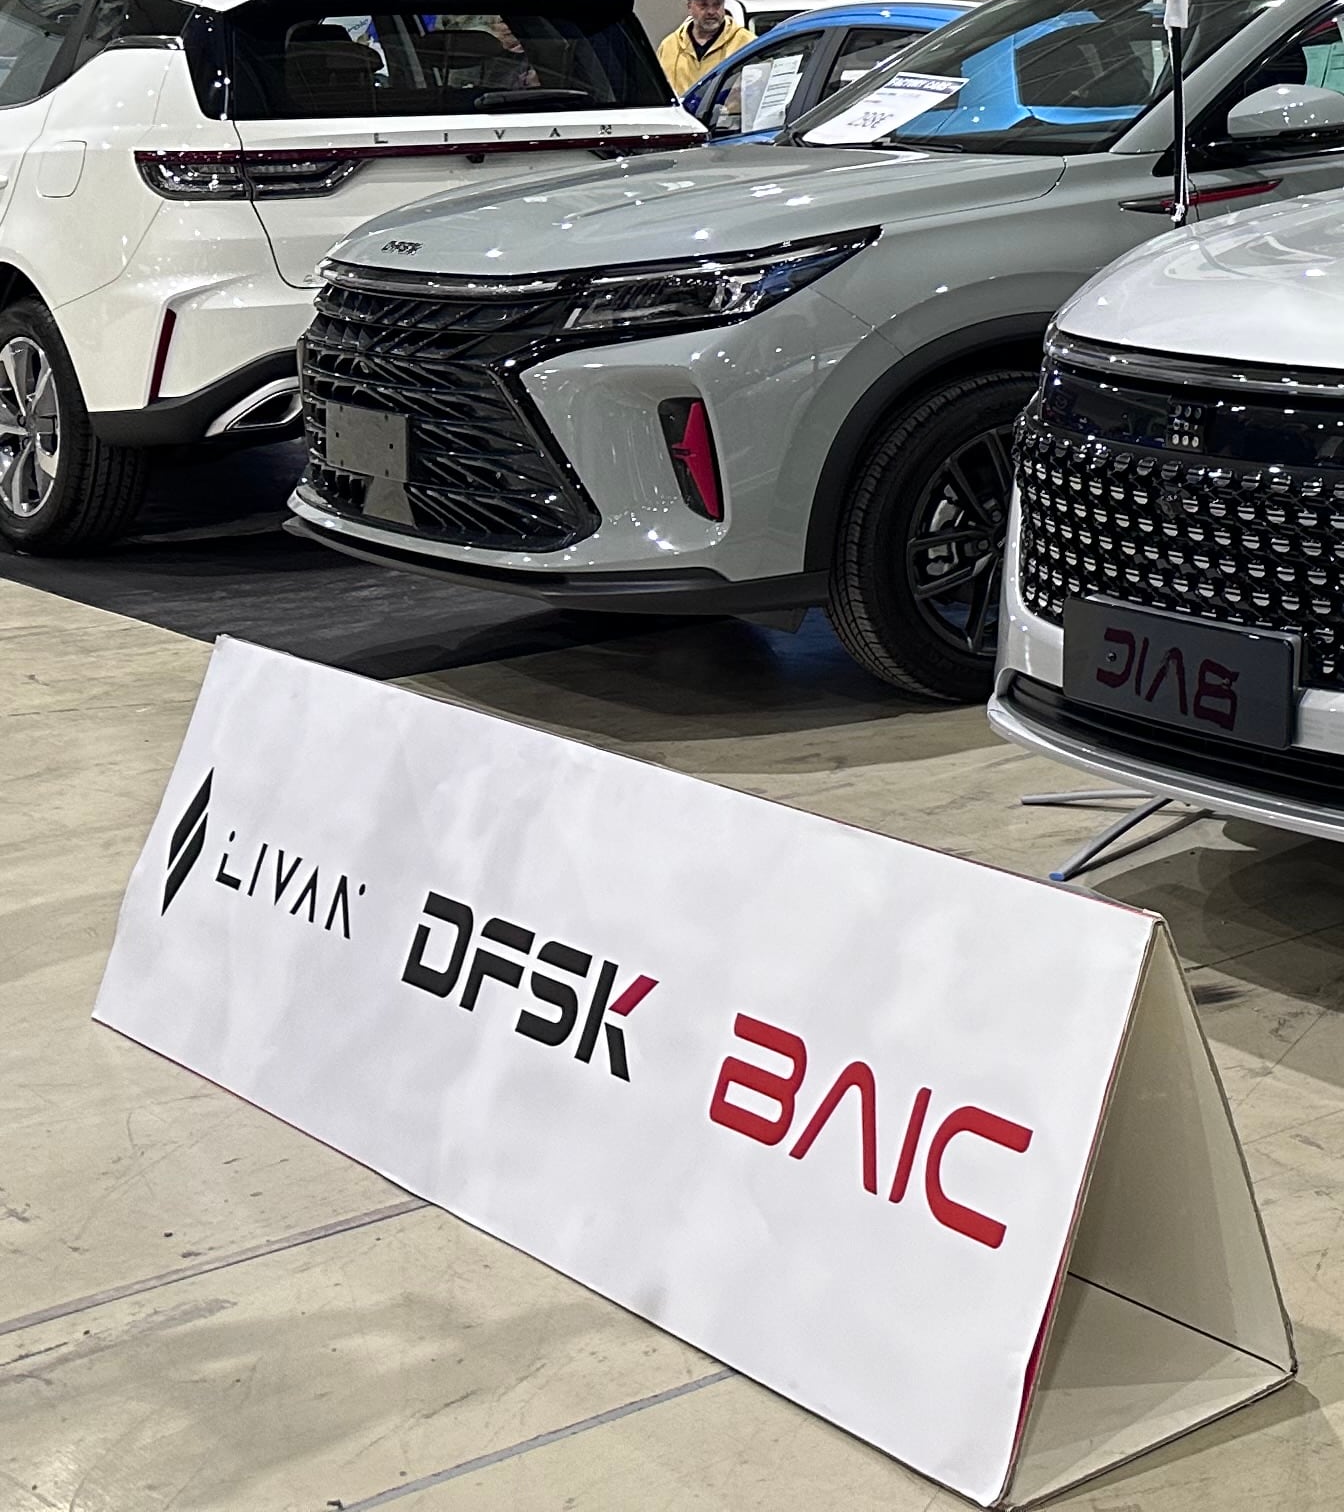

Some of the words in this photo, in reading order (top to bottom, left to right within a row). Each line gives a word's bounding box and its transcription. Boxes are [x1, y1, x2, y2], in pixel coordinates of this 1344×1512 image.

[214, 829, 367, 940] LIVAN
[401, 889, 660, 1083] DFSK
[708, 1011, 1034, 1250] BAIC
